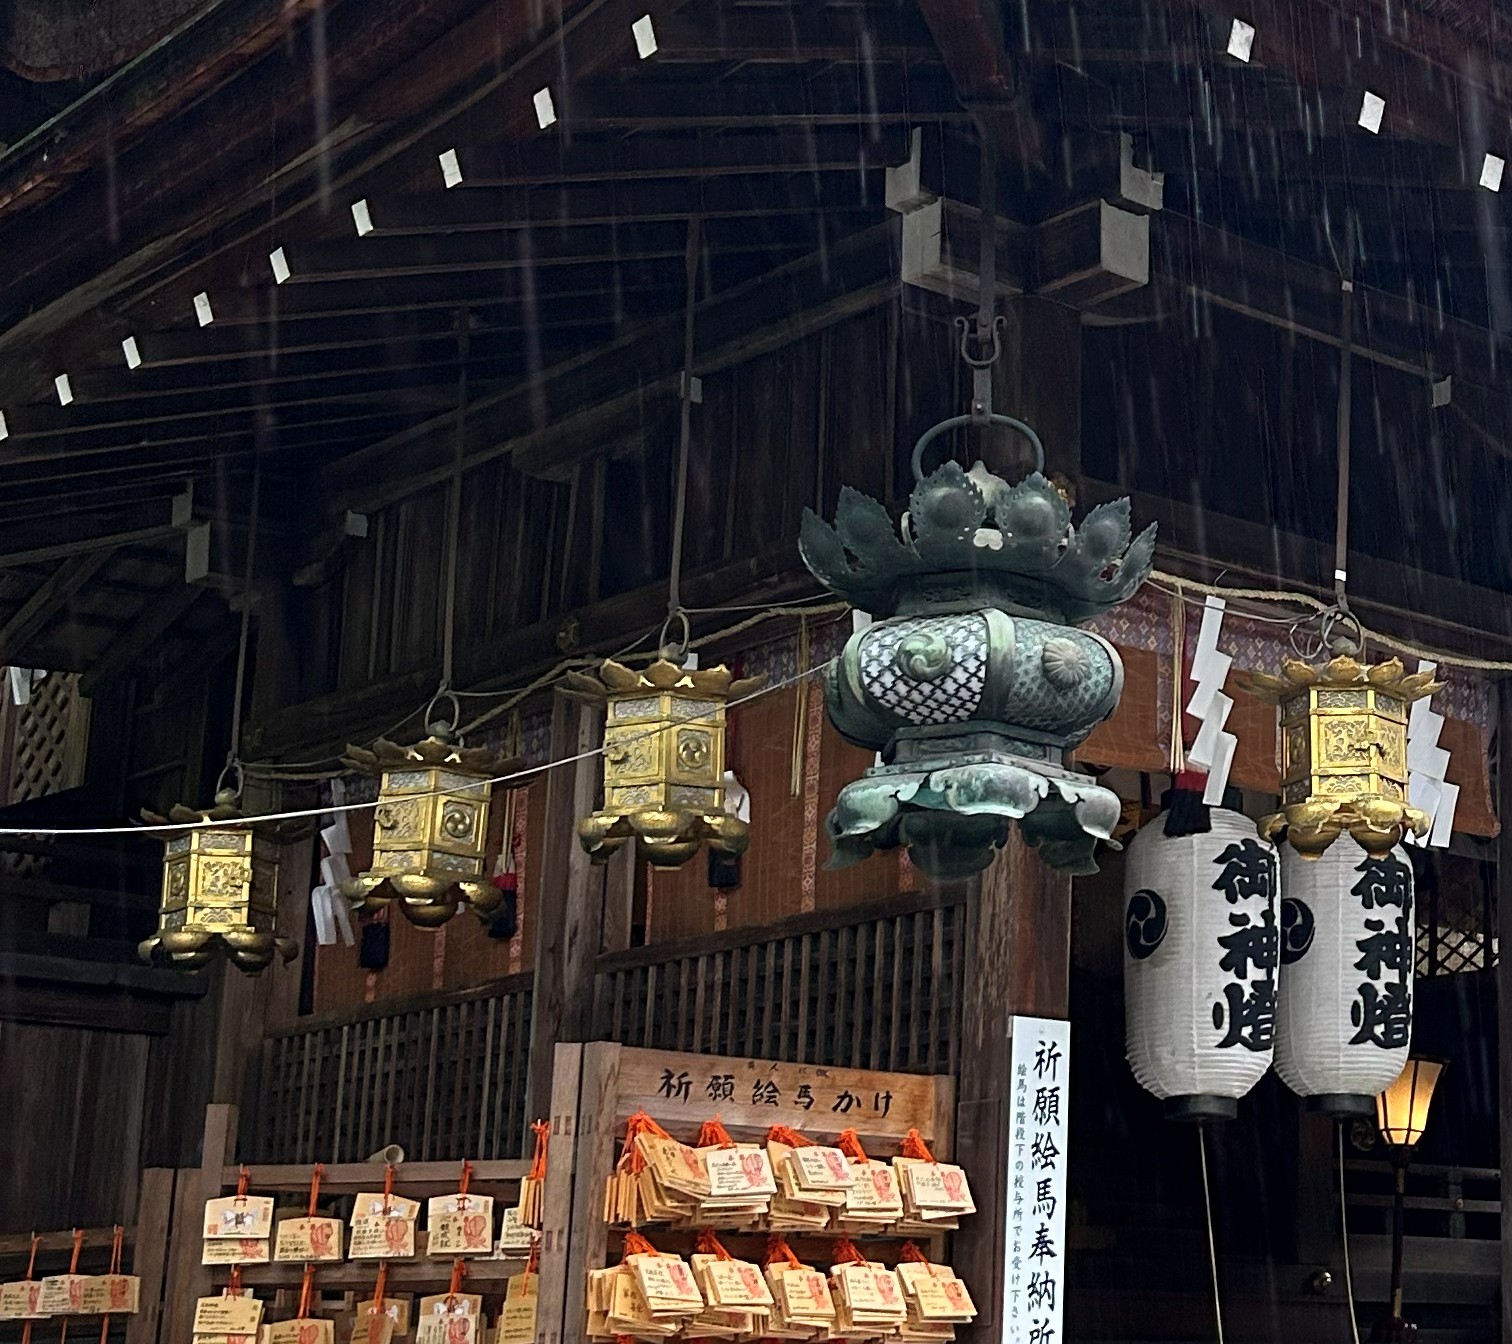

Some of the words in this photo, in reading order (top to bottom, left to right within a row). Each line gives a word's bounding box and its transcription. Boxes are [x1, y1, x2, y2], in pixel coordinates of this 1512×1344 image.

[658, 1067, 893, 1119] 祈願絵馬かけ
